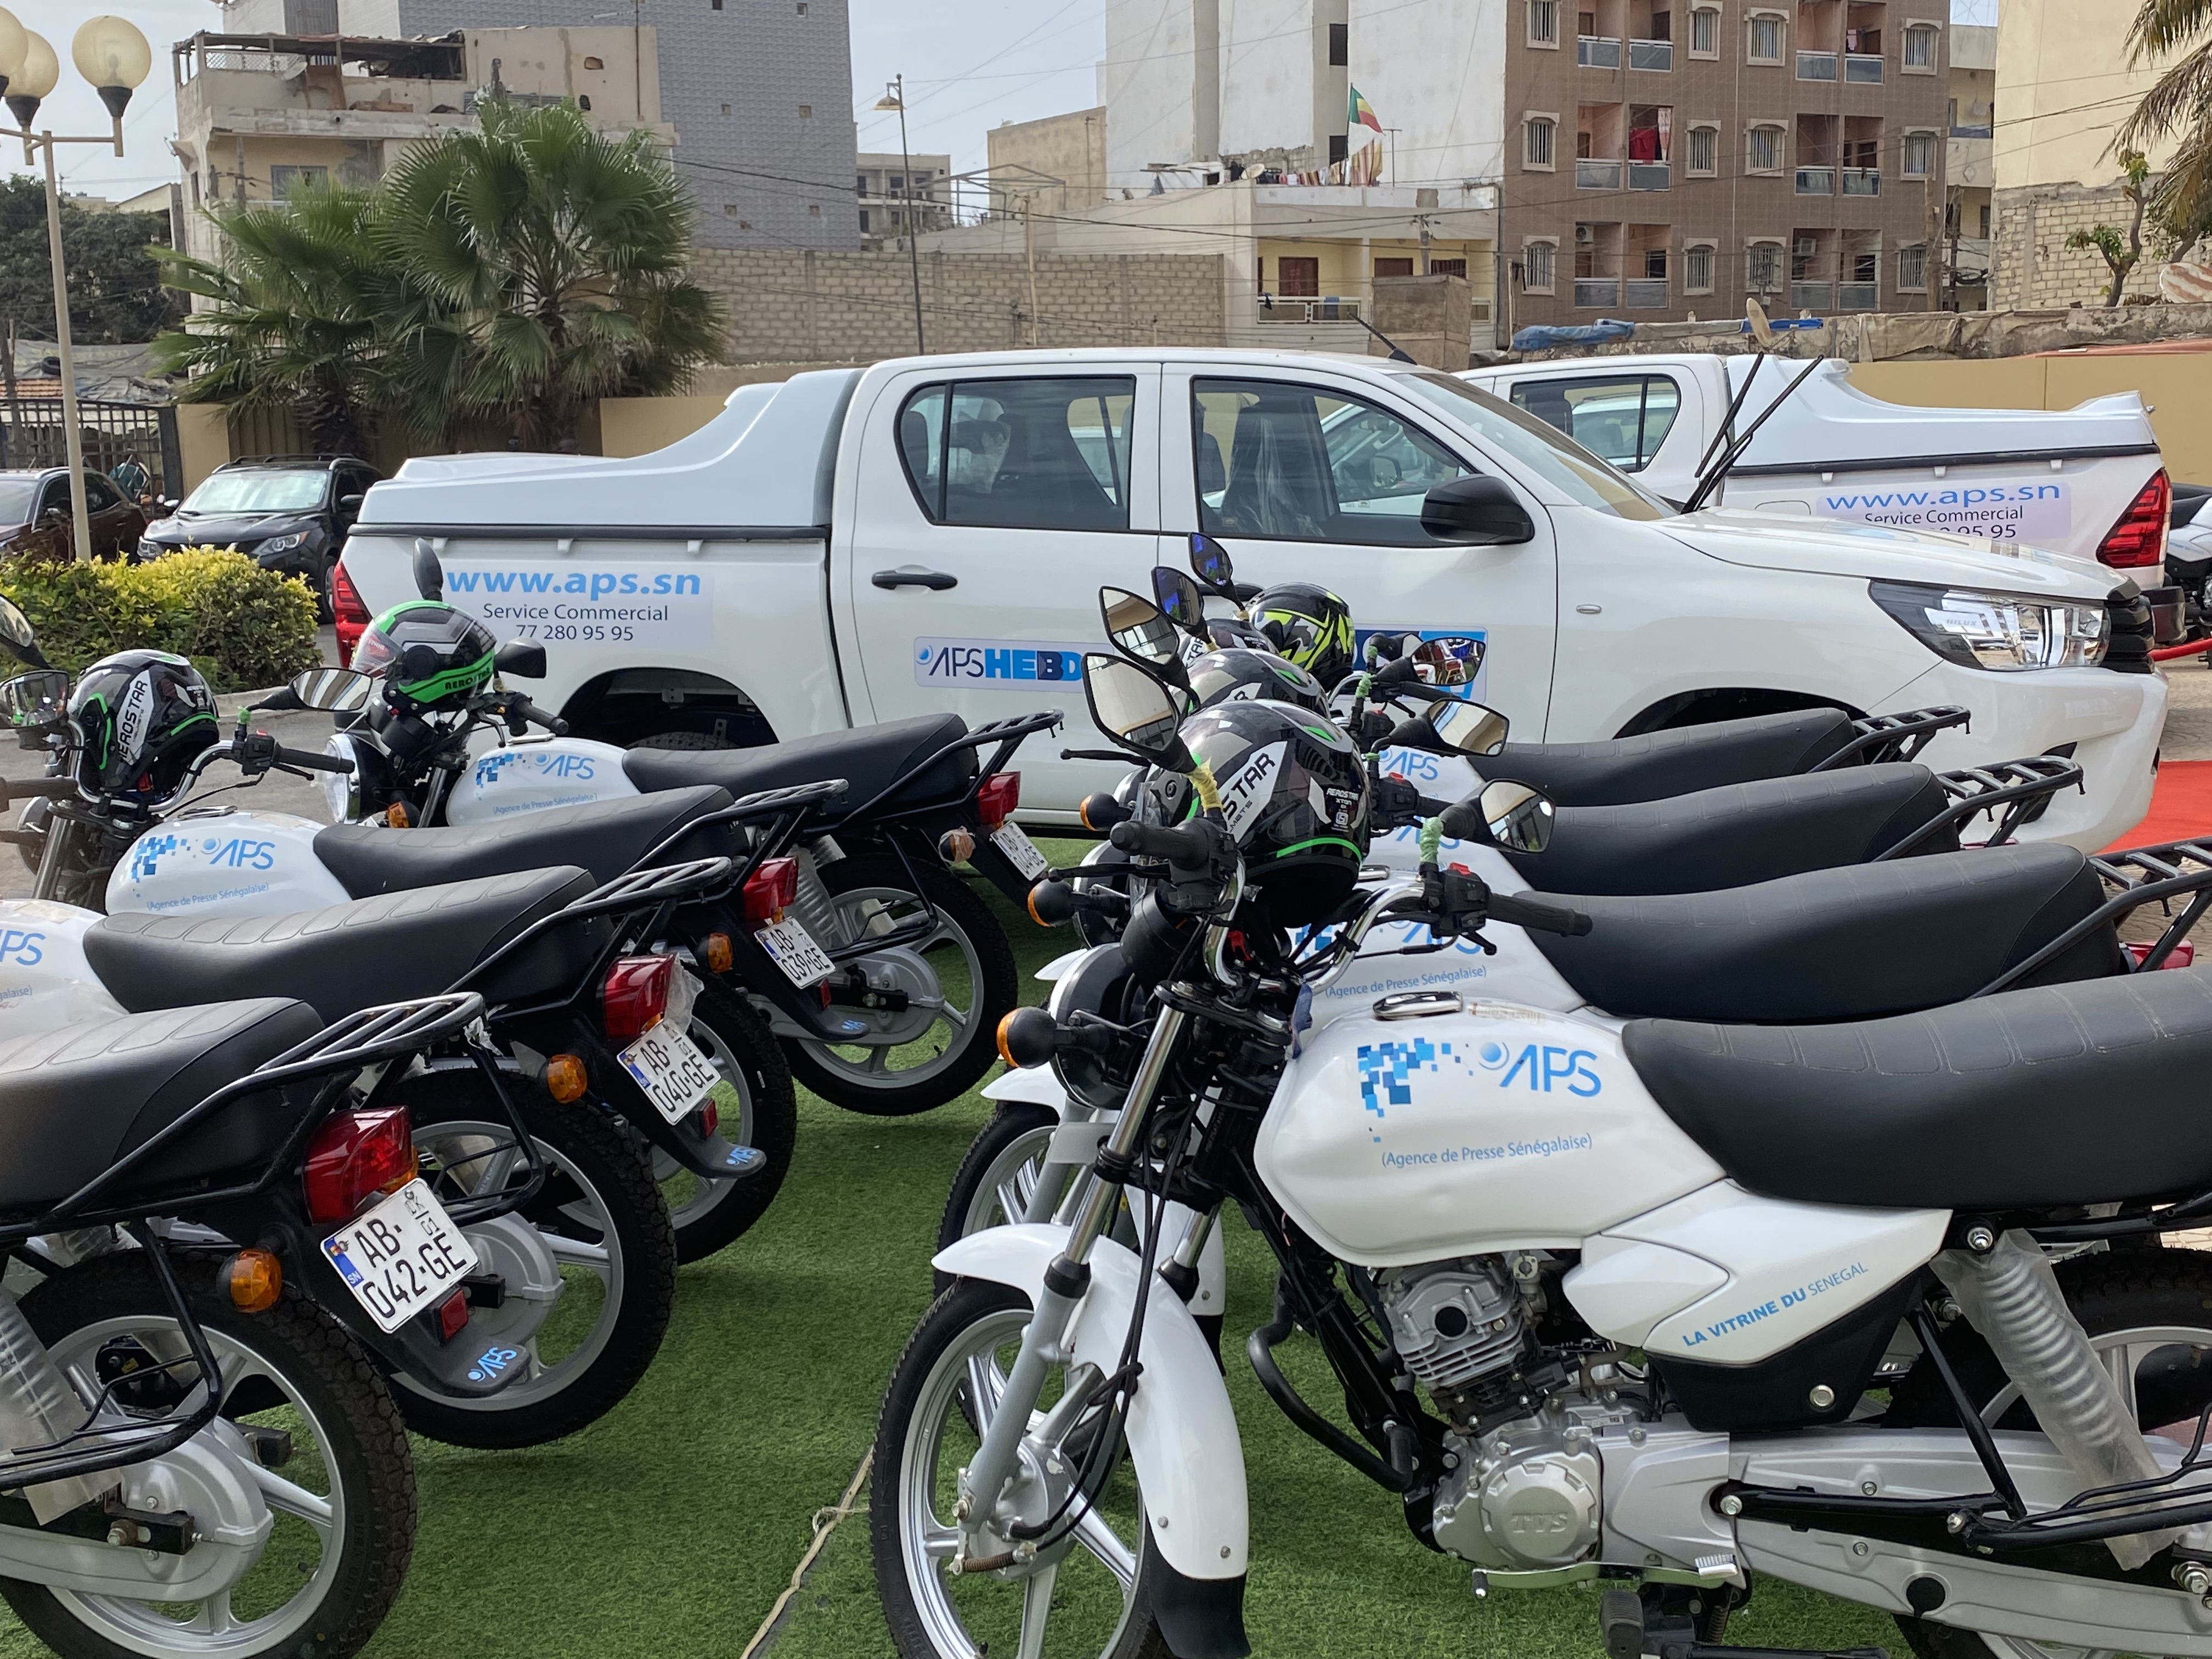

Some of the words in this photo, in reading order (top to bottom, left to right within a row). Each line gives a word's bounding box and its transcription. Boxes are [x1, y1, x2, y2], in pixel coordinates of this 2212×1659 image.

[1826, 484, 2059, 510] www.aps.sn
[1926, 505, 2023, 523] Commercial
[1990, 524, 2016, 538] 95
[447, 572, 701, 601] www.aps.sn
[483, 603, 548, 619] Service
[554, 604, 668, 620] Commercial
[516, 625, 537, 638] 77
[544, 625, 577, 640] 280
[583, 626, 605, 640] 95
[611, 627, 634, 641] 95
[541, 754, 595, 780] APS
[1384, 751, 1439, 781] APS
[1221, 753, 1276, 821] STAR
[209, 838, 276, 870] APS
[180, 896, 191, 906] de
[192, 894, 218, 904] Presse
[0, 929, 46, 966] PS
[1325, 985, 1368, 998] (Agence
[1371, 980, 1384, 992] de
[1386, 977, 1419, 990] Presse
[1421, 965, 1487, 986] Sénégalaise)
[1500, 1044, 1602, 1097] APS
[1381, 1151, 1437, 1168] (Agence
[1441, 1148, 1458, 1163] de
[1462, 1145, 1505, 1161] Presse
[1508, 1132, 1592, 1158] Sénégalaise)
[347, 1272, 362, 1284] SN
[1682, 1330, 1708, 1347] LA
[1707, 1301, 1779, 1338] VITRINE
[1780, 1288, 1807, 1308] DU
[1808, 1262, 1869, 1296] SENEGAL
[1511, 1511, 1568, 1533] TVS
